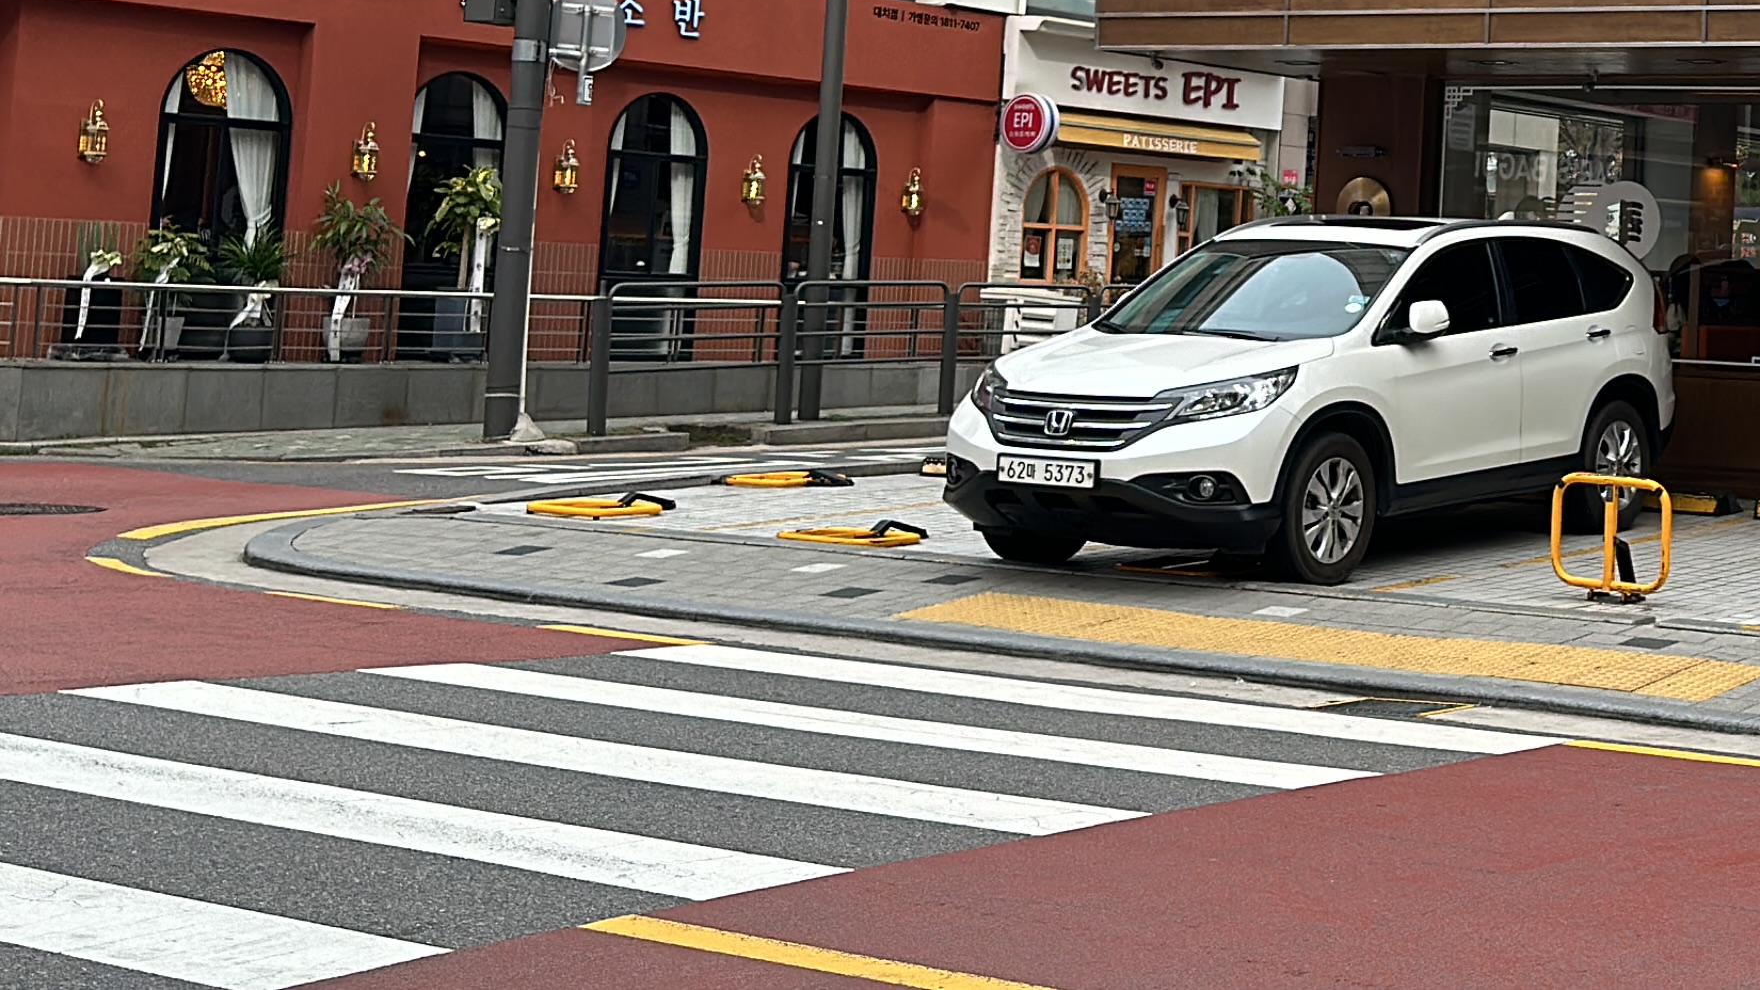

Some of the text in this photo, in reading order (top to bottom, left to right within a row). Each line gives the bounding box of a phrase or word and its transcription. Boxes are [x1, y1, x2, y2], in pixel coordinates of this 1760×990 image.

[1070, 65, 1242, 111] SWEETS EPI
[1013, 112, 1034, 128] EPI
[1122, 133, 1199, 154] PATISSERIE
[1043, 463, 1086, 484] 5373
